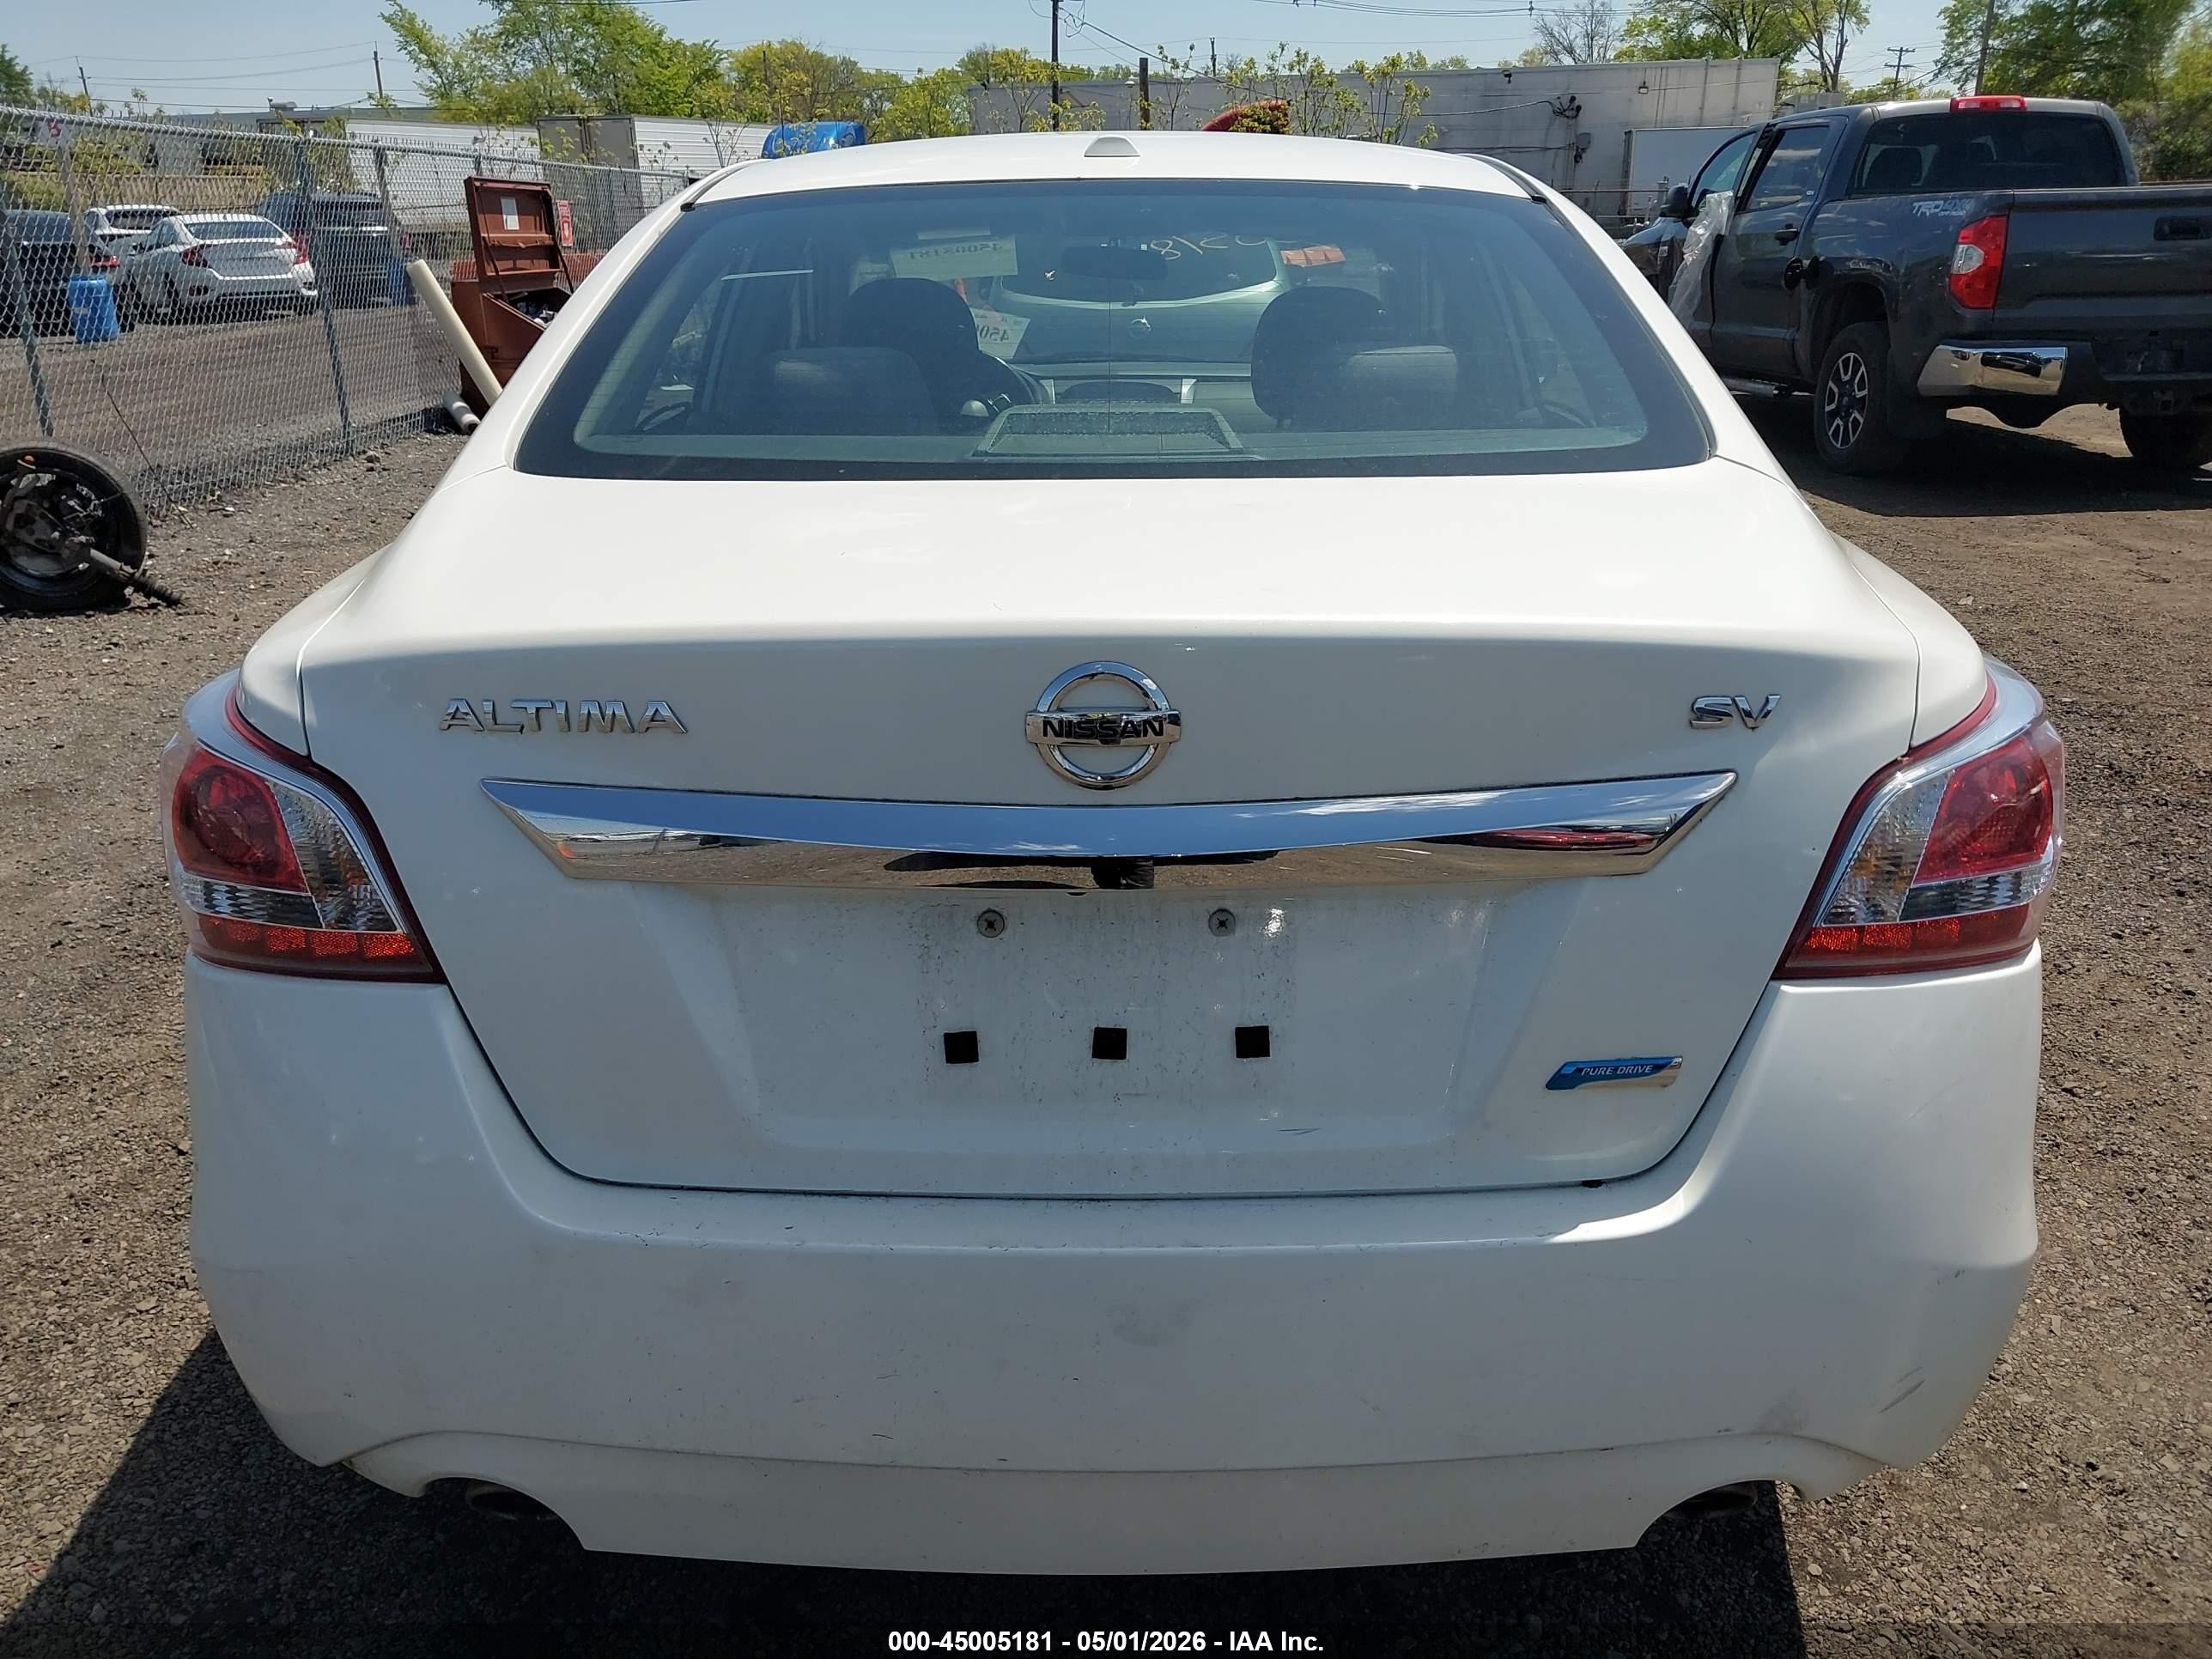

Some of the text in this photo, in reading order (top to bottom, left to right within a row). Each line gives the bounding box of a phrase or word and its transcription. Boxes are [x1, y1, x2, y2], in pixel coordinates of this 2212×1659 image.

[439, 698, 688, 734] ALTIMA
[1689, 694, 1781, 731] SV
[1042, 719, 1165, 738] NISSAN
[1581, 1064, 1654, 1076] PURE DRIVE
